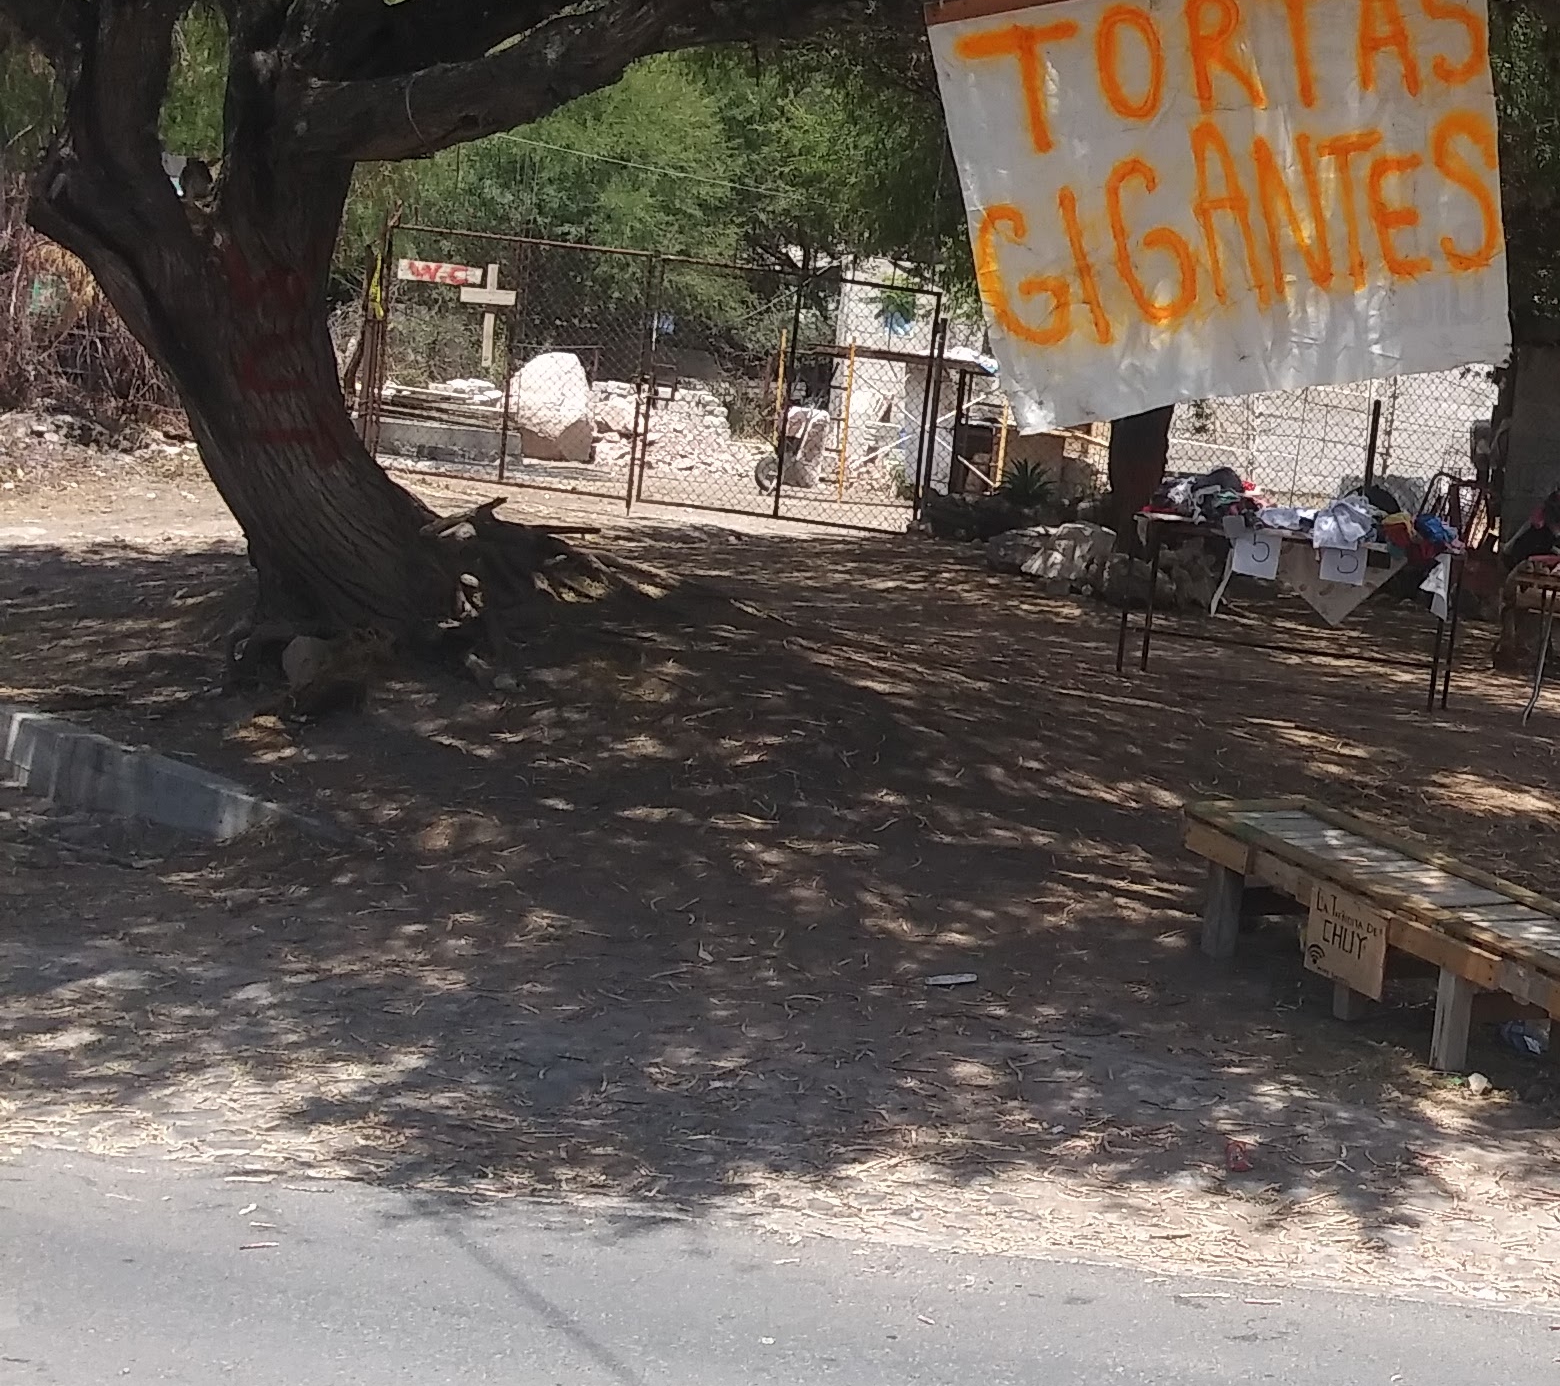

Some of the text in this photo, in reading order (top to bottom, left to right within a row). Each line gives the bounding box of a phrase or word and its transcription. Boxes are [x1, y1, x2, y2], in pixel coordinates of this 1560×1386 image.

[976, 115, 1504, 347] GIGANTES
[1251, 533, 1271, 563] 5
[1336, 549, 1359, 575] 5
[1322, 919, 1368, 960] CHUY
